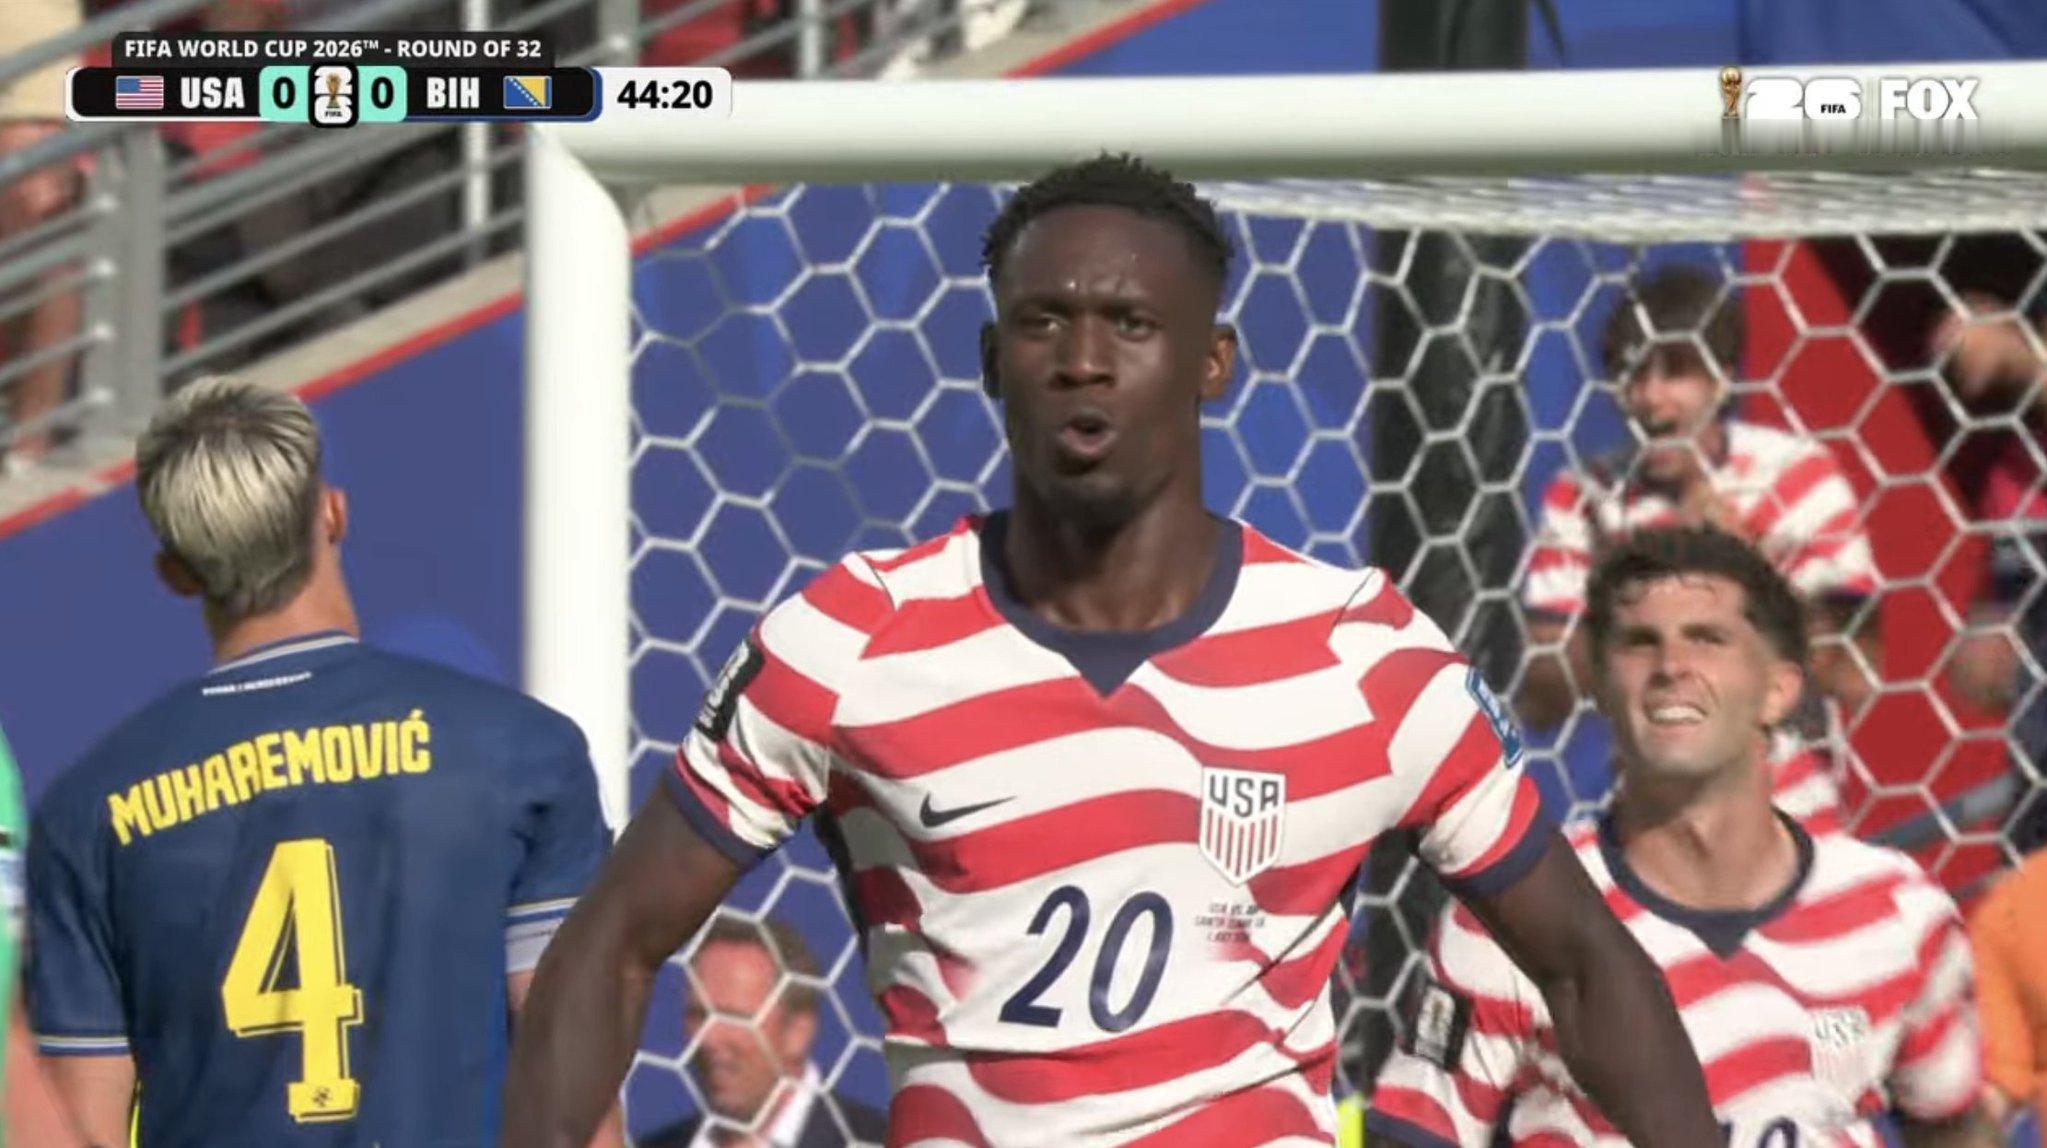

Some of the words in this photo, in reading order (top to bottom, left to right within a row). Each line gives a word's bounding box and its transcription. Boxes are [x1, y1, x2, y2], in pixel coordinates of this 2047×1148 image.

[107, 709, 431, 845] MUHAREMOVIĆ
[1209, 774, 1280, 818] USA
[222, 838, 363, 1122] 4
[998, 884, 1173, 1032] 20
